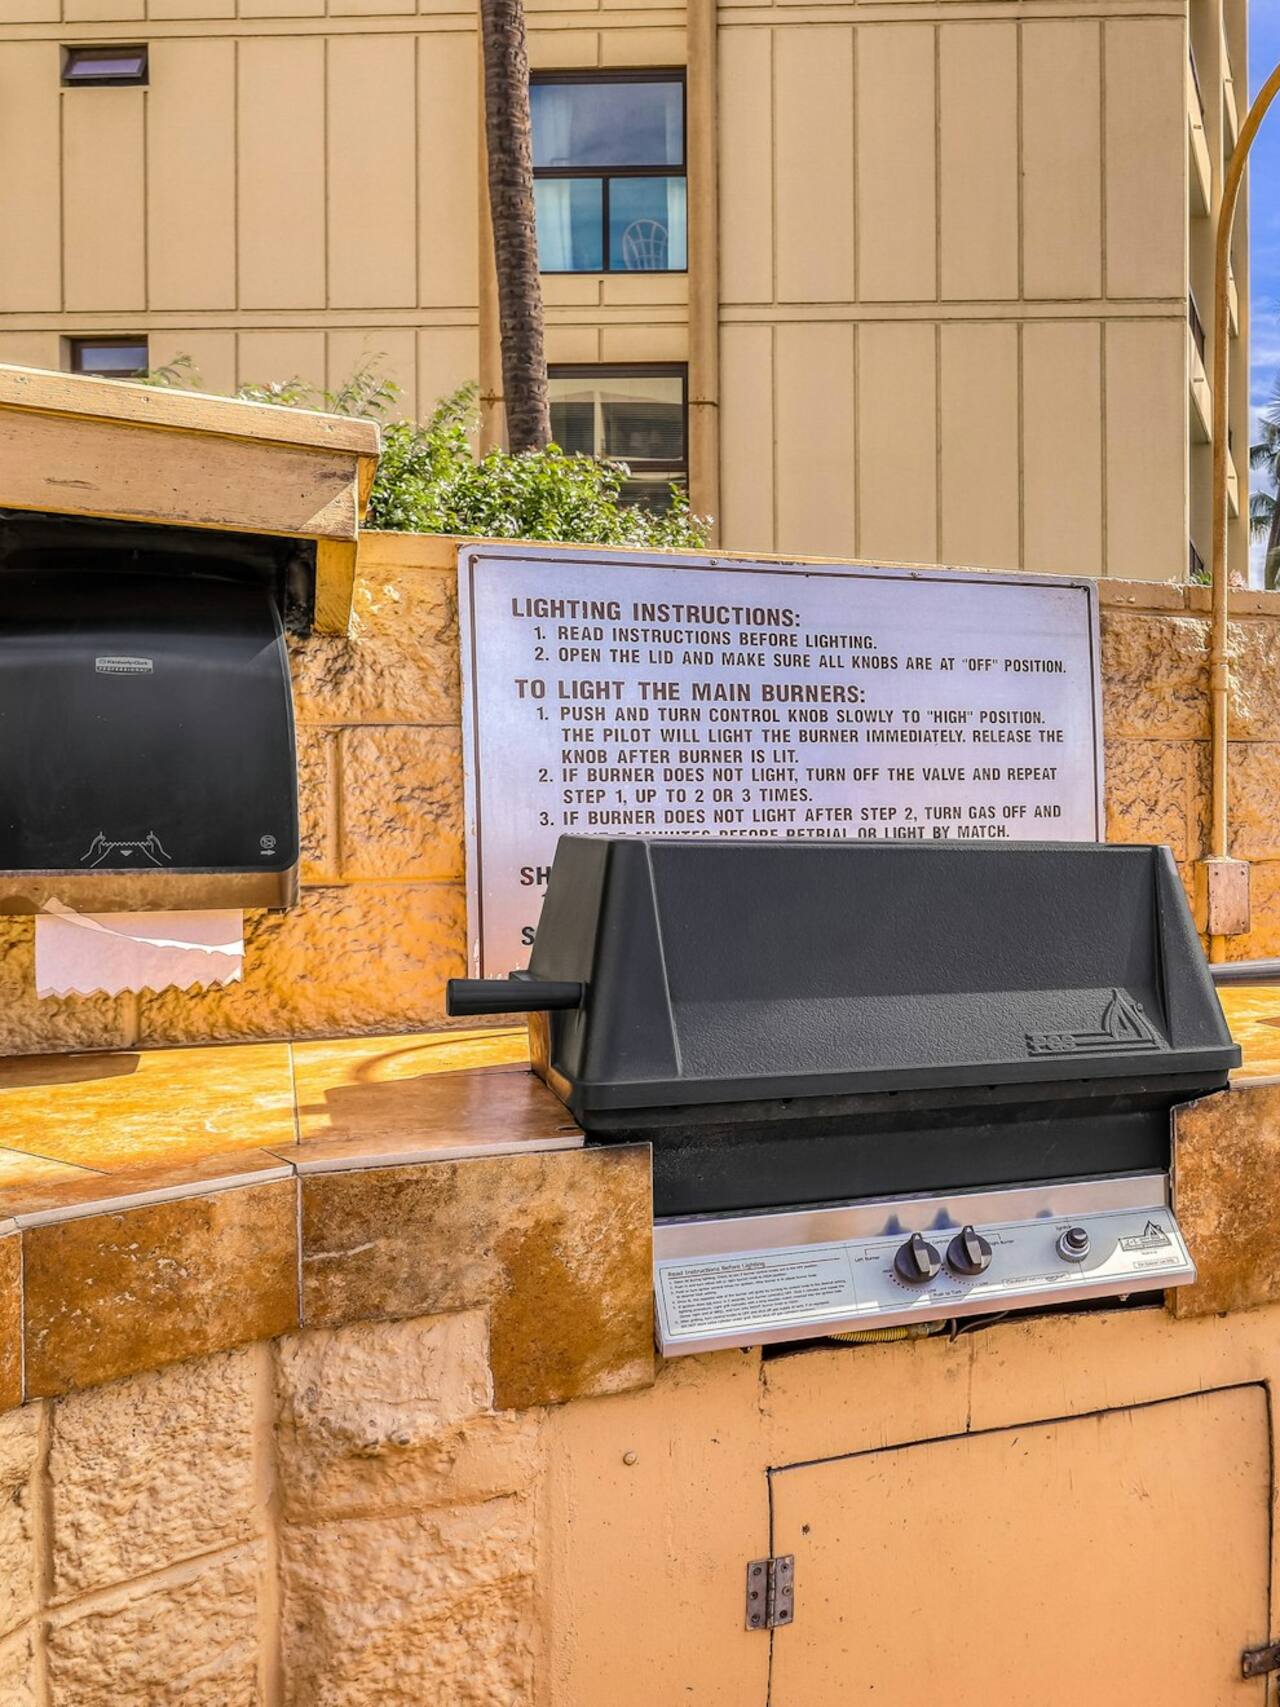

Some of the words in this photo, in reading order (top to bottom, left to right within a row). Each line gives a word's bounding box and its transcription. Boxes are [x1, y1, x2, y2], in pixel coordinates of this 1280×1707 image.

[511, 597, 621, 621] LIGHTING
[632, 602, 801, 628] INSTRUCTIONS:
[533, 625, 546, 641] 1.
[557, 625, 604, 642] READ
[612, 627, 732, 646] INSTRUCTIONS
[739, 631, 798, 648] BEFORE
[805, 634, 878, 650] LIGHTING.
[534, 646, 550, 662] 2.
[558, 646, 601, 663] OPEN
[609, 648, 640, 664] THE
[648, 649, 674, 665] LID
[681, 650, 714, 666] AND
[721, 651, 766, 667] MAKE
[773, 652, 811, 668] SURE
[818, 654, 845, 669] ALL
[851, 655, 899, 670] KNOBS
[905, 656, 933, 671] ARE
[939, 657, 956, 671] AT
[1004, 658, 1067, 674] POSITION.
[514, 679, 546, 699] TO
[558, 679, 625, 701] LIGHT
[637, 681, 681, 701] THE
[691, 682, 751, 702] MAIN
[761, 683, 866, 704] BURNERS:
[536, 706, 549, 721] 1.
[560, 706, 606, 722] PUSH
[614, 706, 649, 722] AND
[657, 707, 701, 722] TURN
[708, 707, 781, 723] CONTROL
[787, 708, 829, 724] KNOB
[836, 709, 894, 724] SLOWLY
[901, 709, 921, 724] TO
[979, 710, 1046, 725] POSITION.
[561, 727, 595, 743] THE
[602, 727, 652, 743] PILOT
[659, 728, 701, 743] WILL
[708, 728, 753, 744] LIGHT
[761, 728, 791, 744] THE
[798, 728, 859, 744] BURNER
[866, 729, 966, 743] IMMEDIATELY.
[972, 729, 1032, 744] RELEASE
[1037, 729, 1064, 743] THE
[561, 749, 608, 764] KNOB
[616, 749, 671, 764] AFTER
[678, 749, 743, 764] BURNER
[751, 749, 766, 764] IS
[772, 749, 799, 764] LIT.
[538, 767, 554, 783] 2.
[562, 767, 579, 783] IF
[587, 767, 655, 783] BURNER
[663, 767, 705, 783] DOES
[712, 767, 744, 782] NOT
[751, 767, 799, 785] LIGHT,
[805, 767, 846, 782] TURN
[852, 767, 880, 782] OFF
[887, 767, 915, 782] THE
[922, 767, 966, 782] VALVE
[972, 767, 1001, 781] AND
[1007, 767, 1058, 781] REPEAT
[563, 788, 606, 805] STEP
[615, 789, 628, 807] 1,
[635, 788, 657, 804] UP
[665, 788, 687, 803] TO
[694, 788, 705, 803] 2
[712, 787, 734, 803] OR
[741, 788, 751, 803] 3
[759, 787, 813, 803] TIMES.
[539, 811, 555, 827] 3.
[563, 810, 579, 826] IF
[587, 809, 656, 826] BURNER
[663, 808, 706, 825] DOES
[713, 808, 745, 824] NOT
[752, 808, 797, 823] LIGHT
[804, 807, 853, 822] AFTER
[860, 807, 897, 821] STEP
[904, 806, 918, 822] 2,
[924, 806, 962, 820] TURN
[968, 805, 996, 820] GAS
[1002, 804, 1027, 819] OFF
[1033, 804, 1062, 819] AND
[884, 826, 925, 839] LIGHT
[932, 826, 950, 839] BY
[957, 825, 1010, 838] MATCH.
